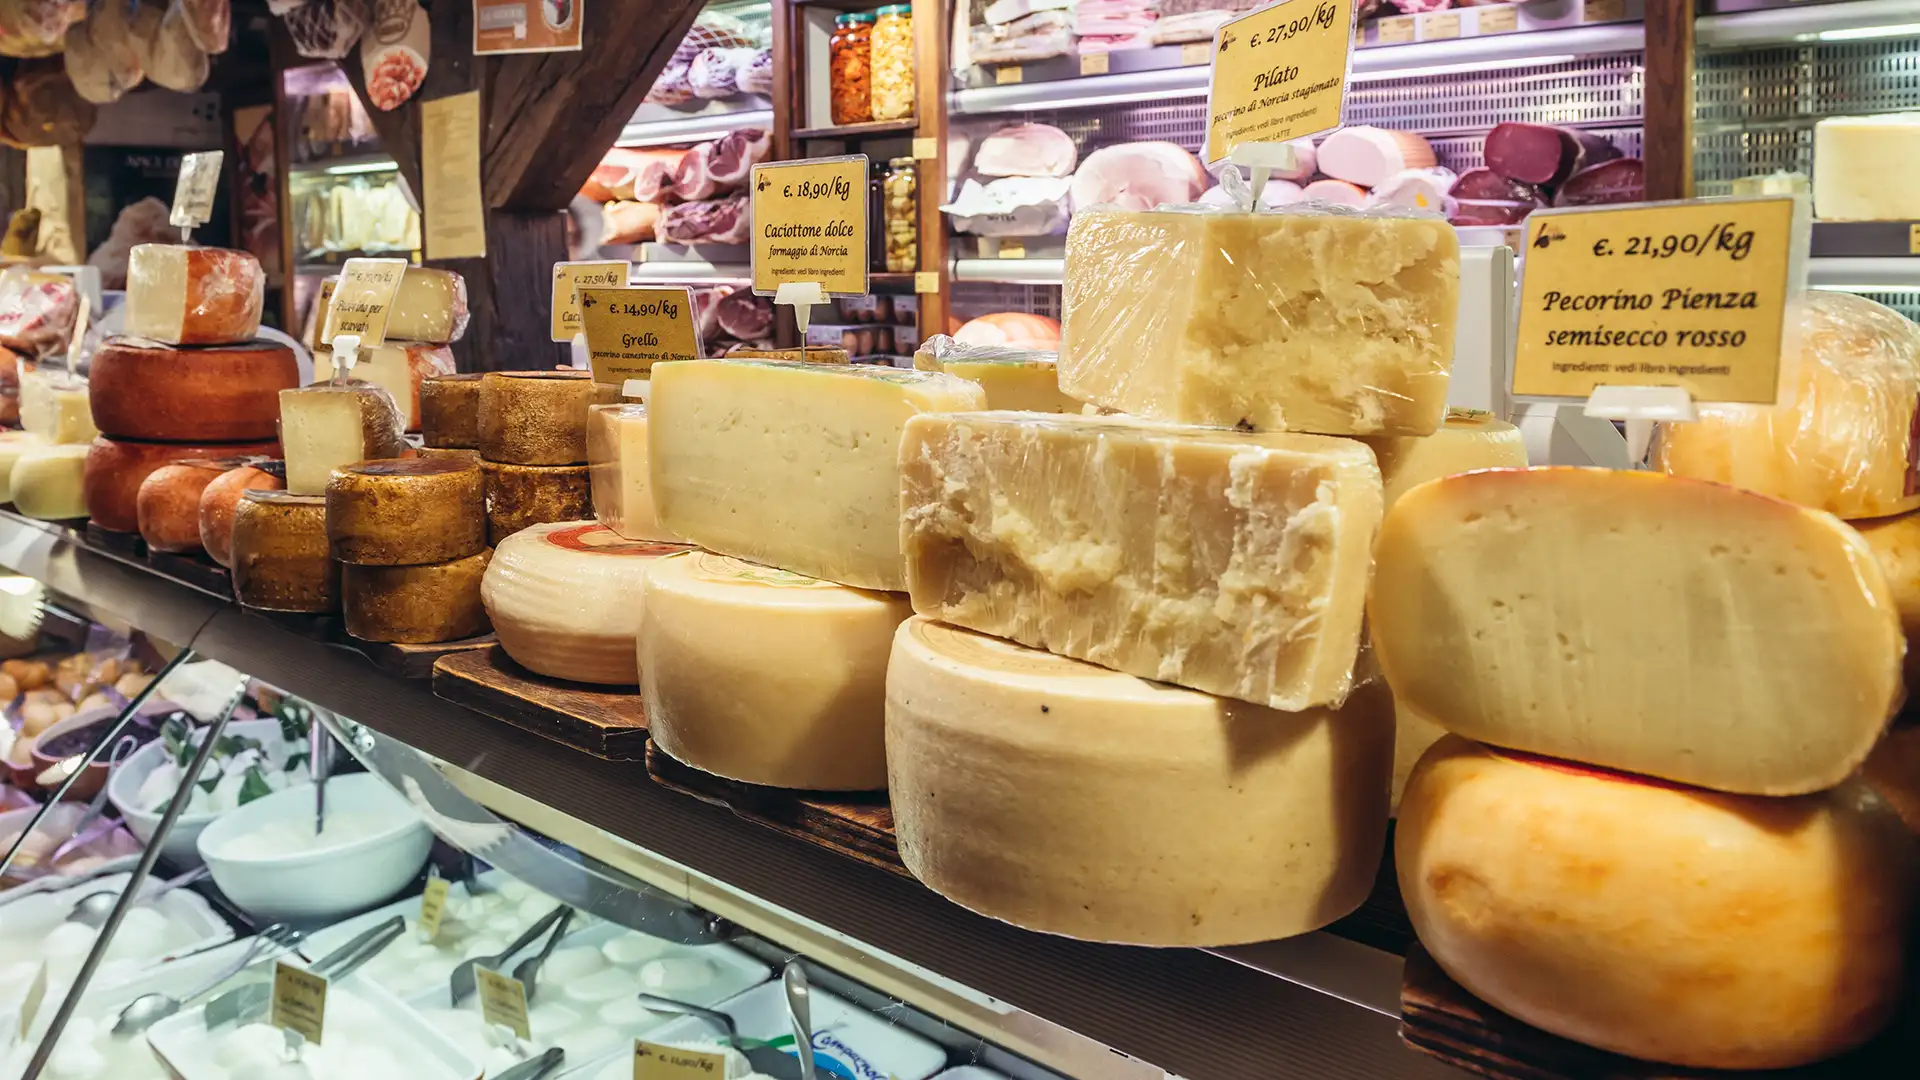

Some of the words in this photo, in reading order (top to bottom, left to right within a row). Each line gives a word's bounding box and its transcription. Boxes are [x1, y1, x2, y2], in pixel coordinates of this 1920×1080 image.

[1250, 33, 1261, 48] €.
[1266, 1, 1336, 43] 27,90/kg
[1253, 65, 1299, 92] Pilato
[1212, 106, 1246, 128] pecorino
[1247, 100, 1257, 113] di
[1257, 91, 1289, 110] Norcia
[1291, 77, 1340, 100] stagionato
[1257, 120, 1269, 130] vedi
[1270, 117, 1284, 126] libro
[1272, 128, 1291, 140] LATTE
[783, 185, 793, 198] €.
[797, 176, 851, 201] 18,90/kg
[764, 223, 822, 238] Caciottone
[824, 220, 854, 237] dolce
[1593, 239, 1614, 256] €.
[1624, 222, 1755, 260] 21,90/kg
[768, 245, 808, 260] formaggio
[809, 244, 818, 256] di
[819, 245, 848, 256] Norcia
[1543, 289, 1653, 311] Pecorino
[1661, 288, 1758, 310] Pienza
[366, 304, 384, 318] per
[609, 304, 620, 314] €.
[623, 300, 678, 319] 14,90/kg
[340, 321, 369, 332] scavato
[622, 333, 658, 348] Grello
[1545, 326, 1667, 347] semisecco
[1675, 329, 1747, 348] rosso
[592, 350, 620, 359] pecorino
[621, 352, 659, 360] canestrato
[660, 351, 669, 360] di
[670, 353, 695, 361] Norcia
[1615, 361, 1637, 374] vedi
[1640, 362, 1665, 374] libro
[1669, 364, 1730, 376] ingredienti
